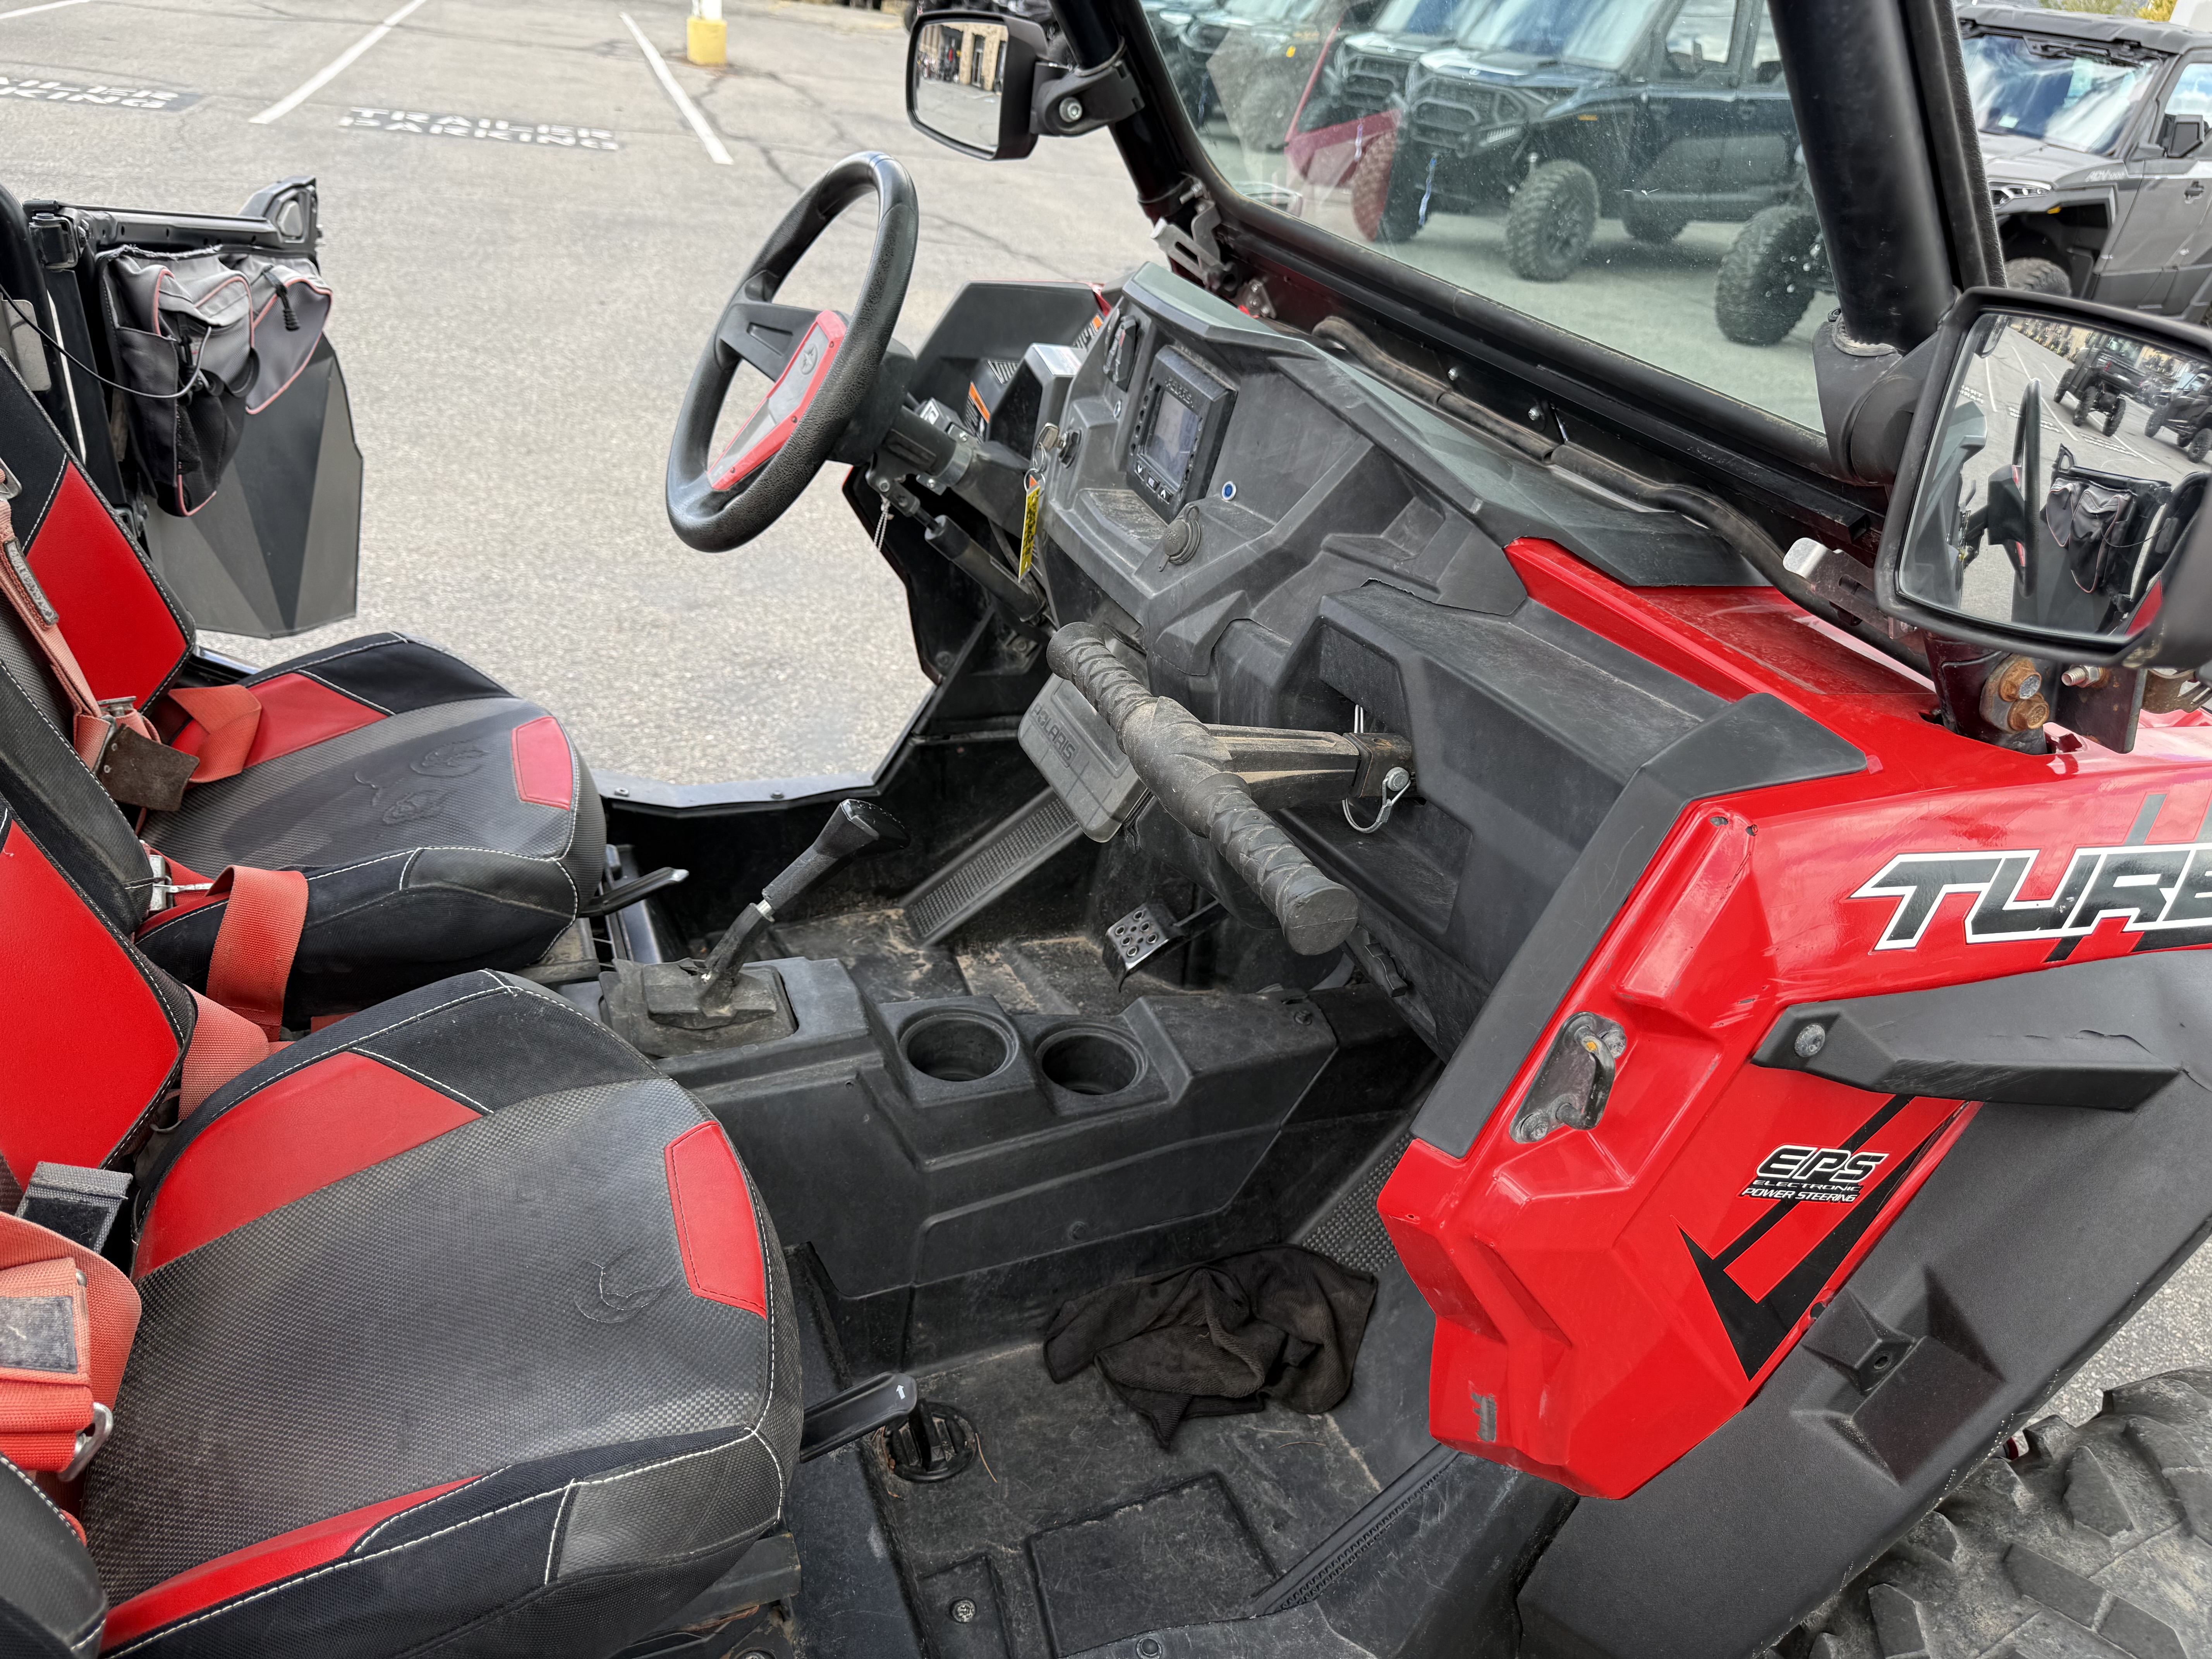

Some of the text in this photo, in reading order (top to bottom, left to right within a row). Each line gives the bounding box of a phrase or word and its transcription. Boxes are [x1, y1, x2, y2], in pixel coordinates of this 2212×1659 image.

[0, 77, 179, 101] ILER
[338, 116, 619, 150] PARKING
[350, 106, 613, 140] TRAILER
[1031, 702, 1076, 761] POLARIS
[1756, 1144, 1890, 1183] EPS
[1742, 1188, 1858, 1202] POWER STEERING
[1753, 1180, 1861, 1192] ELECTRONIC
